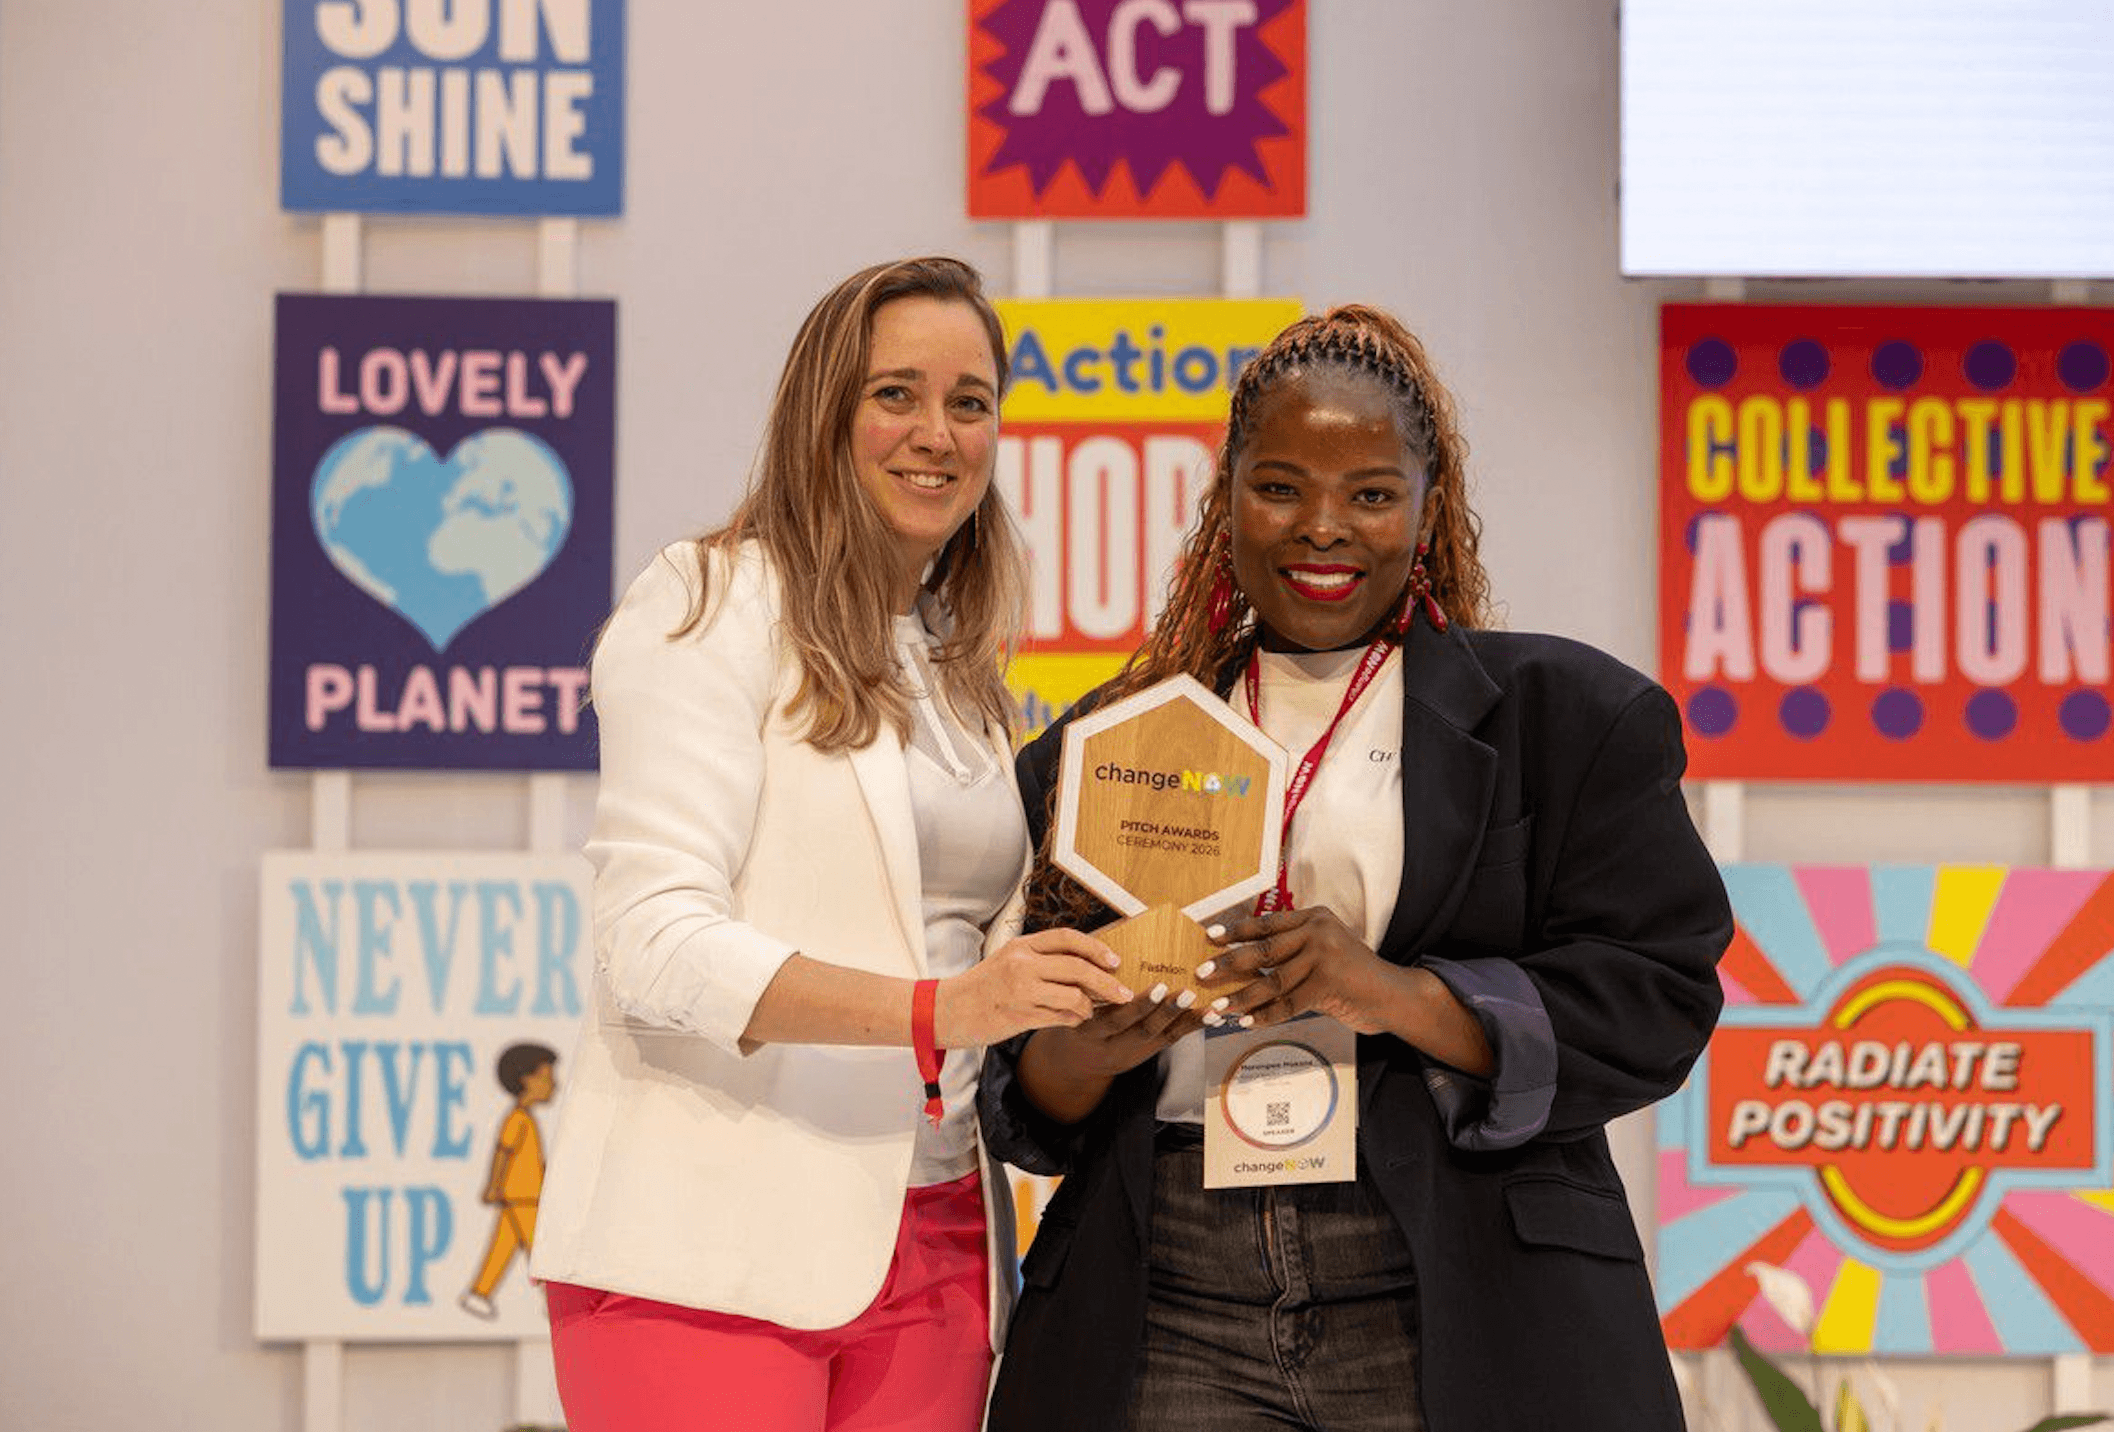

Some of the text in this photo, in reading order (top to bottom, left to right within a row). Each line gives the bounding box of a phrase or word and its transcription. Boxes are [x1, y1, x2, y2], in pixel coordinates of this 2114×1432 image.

[1008, 0, 1258, 116] ACT
[315, 66, 594, 180] SHINE
[318, 347, 588, 418] LOVELY
[1687, 396, 2111, 504] COLLECTIVE
[995, 435, 1216, 640] HOP
[1683, 512, 2112, 687] ACTION
[305, 664, 589, 734] PLANET
[1116, 835, 1221, 857] CEREMONY 2026
[1120, 820, 1220, 841] PITCH AWARDS
[287, 878, 583, 1018] NEVER
[1140, 961, 1187, 975] Fashion
[286, 1039, 476, 1162] GIVE
[1764, 1039, 2022, 1091] RADIATE
[1727, 1100, 2062, 1154] POSITIVITY
[340, 1185, 454, 1308] UP
